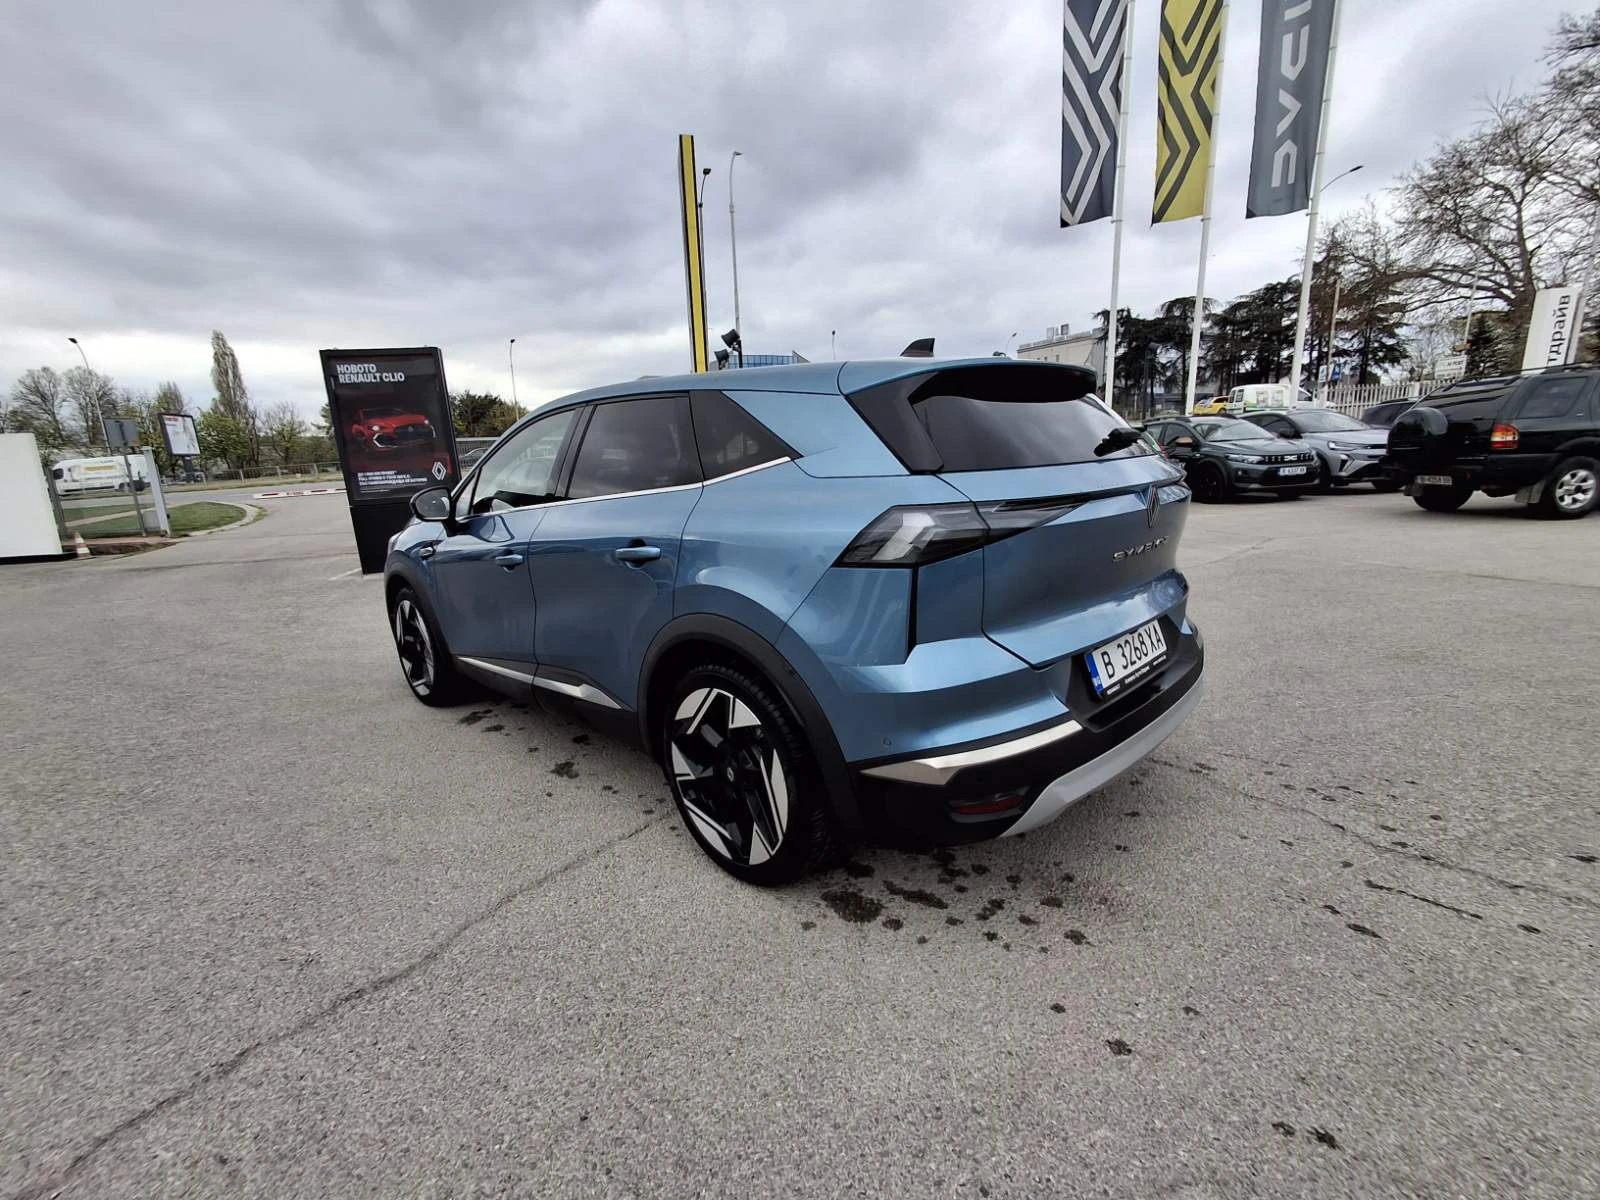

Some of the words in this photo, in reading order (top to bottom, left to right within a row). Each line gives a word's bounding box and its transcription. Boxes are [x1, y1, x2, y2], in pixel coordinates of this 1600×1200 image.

[336, 363, 377, 374] НОВОТО
[338, 373, 380, 383] RENAULT
[382, 372, 405, 382] CLIO
[1101, 650, 1115, 679] B
[1117, 632, 1149, 669] 3268
